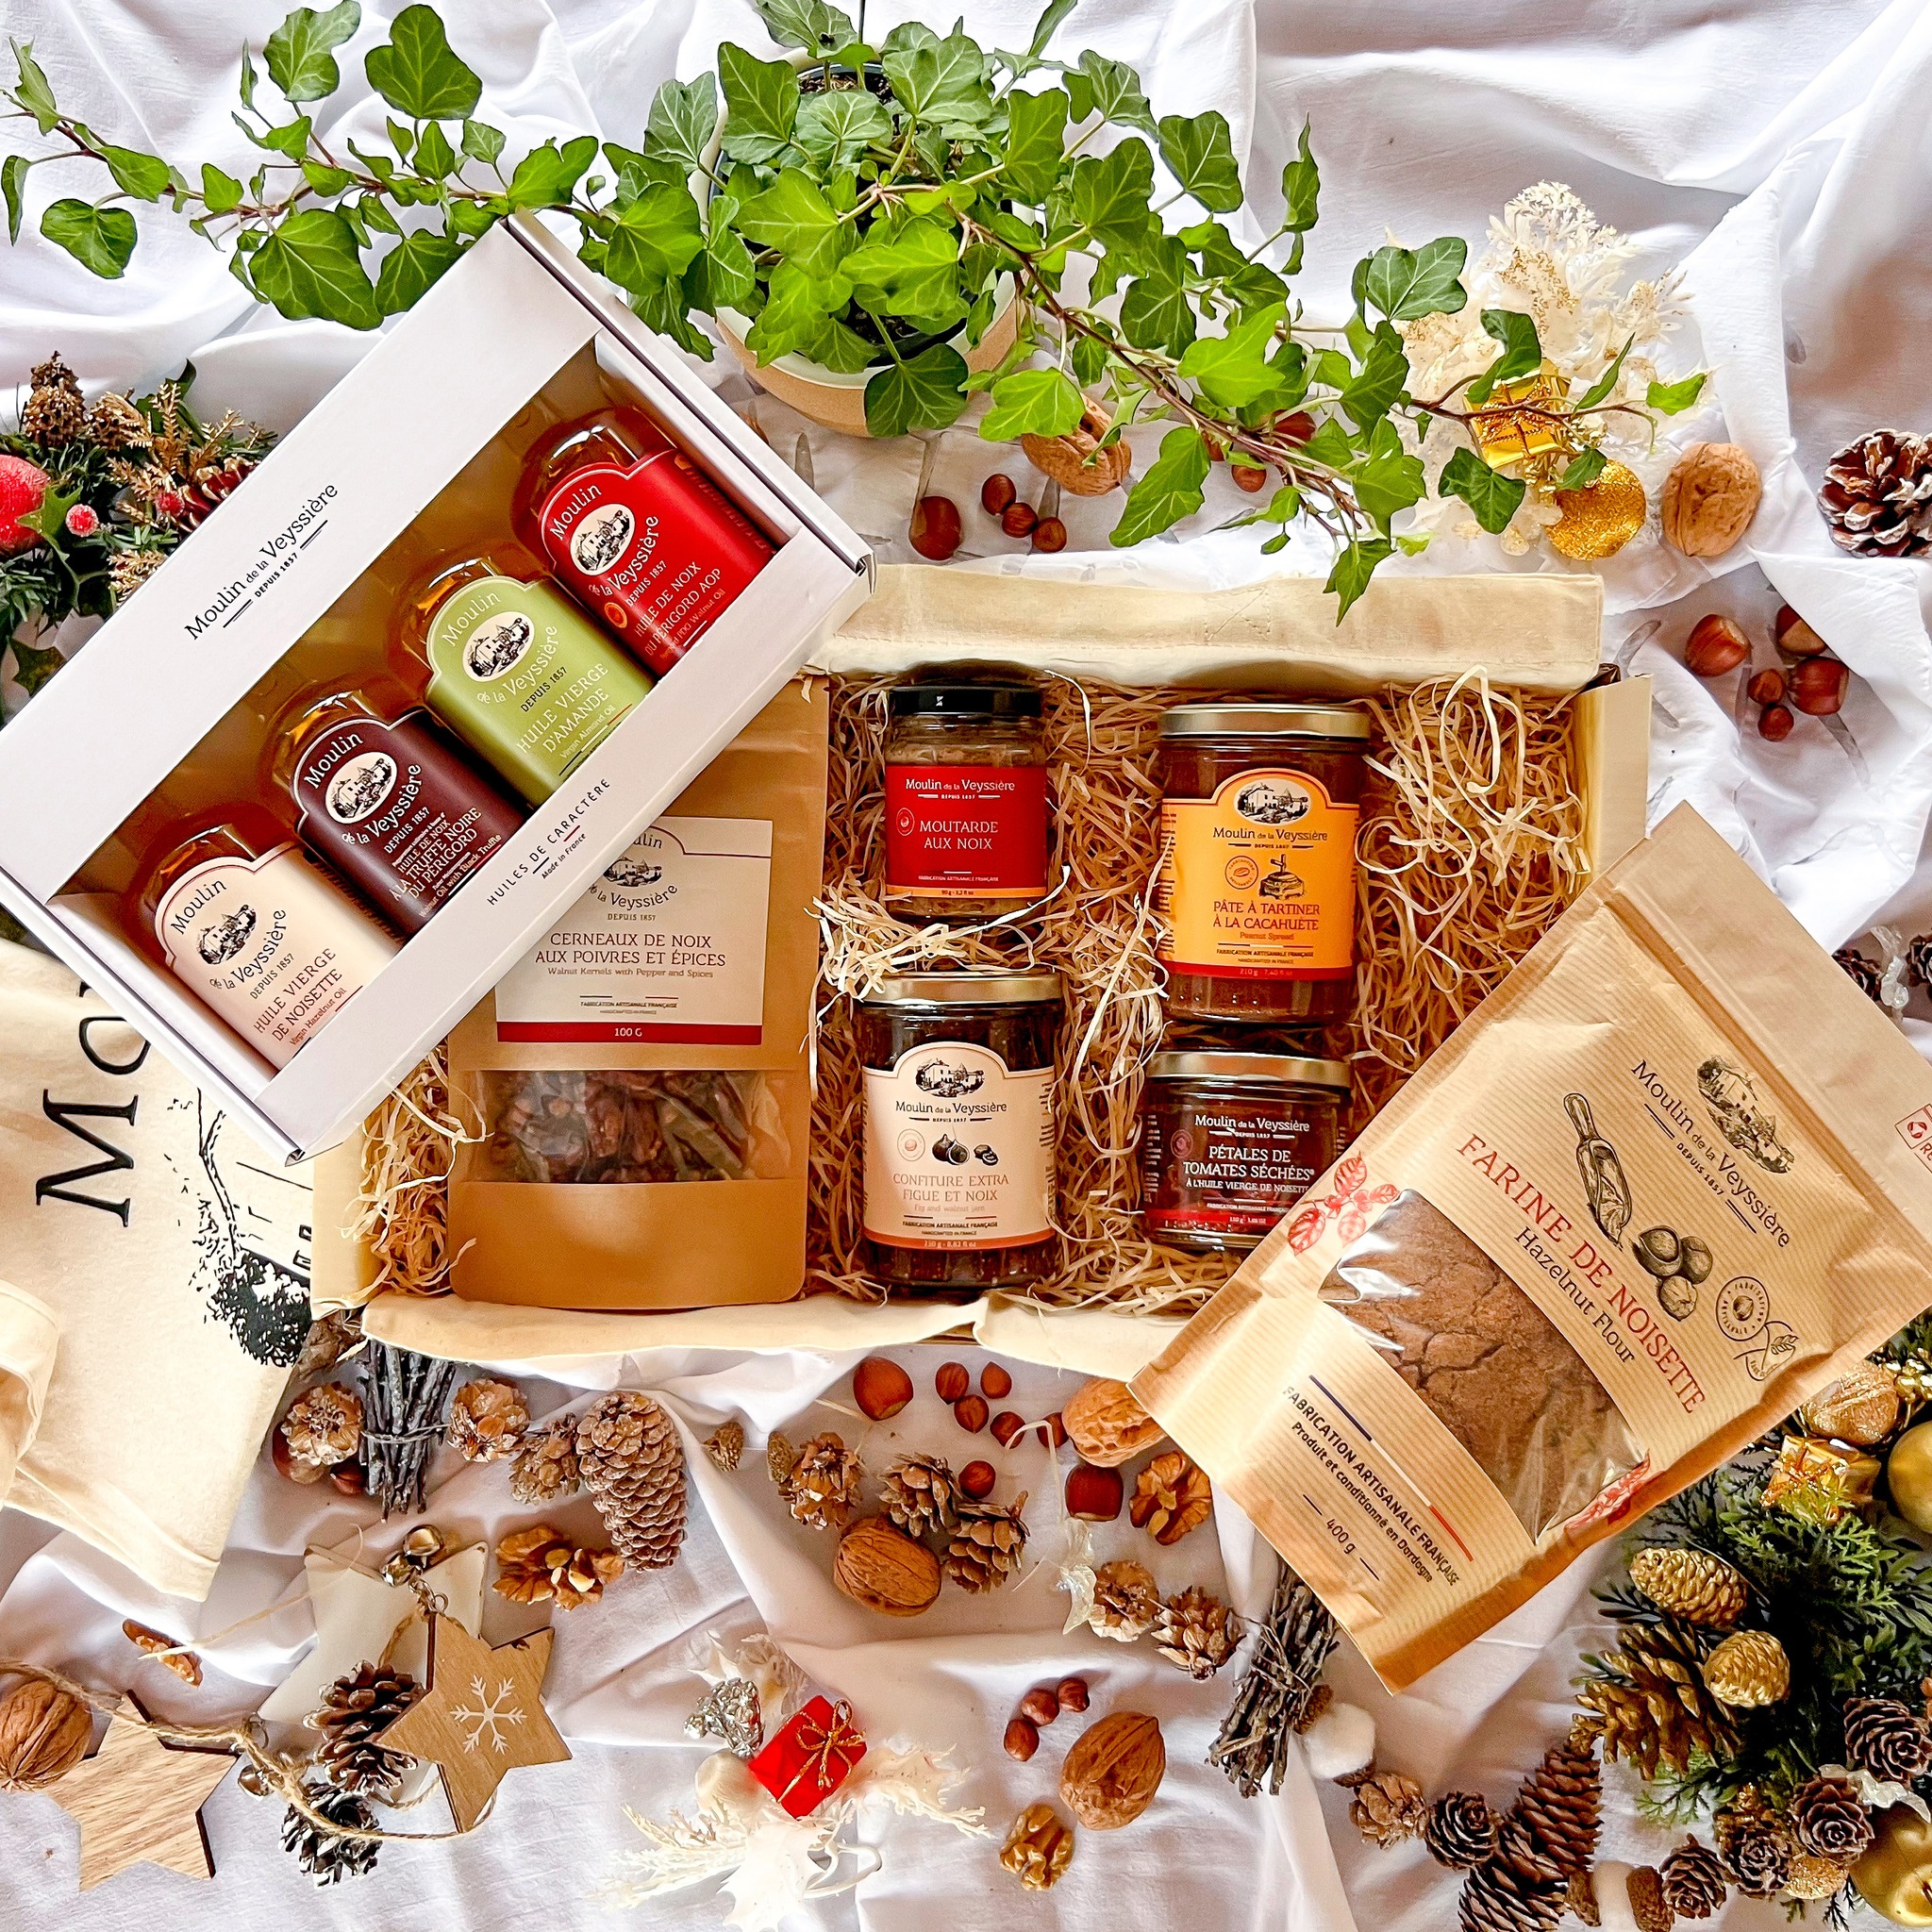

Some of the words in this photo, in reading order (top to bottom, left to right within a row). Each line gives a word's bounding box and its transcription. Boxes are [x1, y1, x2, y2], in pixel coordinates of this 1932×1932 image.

[258, 484, 339, 558] Veyssière
[549, 483, 602, 541] Moulin
[600, 583, 613, 596] la
[607, 515, 659, 591] Veyssière
[245, 570, 259, 584] de
[254, 571, 281, 598] DEPUIS
[280, 552, 298, 572] 1857
[256, 559, 270, 572] la
[625, 577, 652, 608] DEPUIS
[649, 559, 667, 579] 1857
[184, 580, 247, 641] Moulin
[634, 606, 659, 638] HUILE
[655, 589, 674, 608] DE
[670, 561, 702, 593] NOIX
[644, 640, 658, 657] DU
[698, 568, 722, 594] AOP
[713, 588, 726, 601] Oil
[441, 591, 501, 647] Moulin
[493, 691, 506, 704] la
[502, 625, 558, 696] Veyssière
[516, 709, 558, 755] HUILE
[555, 663, 608, 709] VIERGE
[520, 682, 551, 712] DEPUIS
[550, 667, 568, 685] 1857
[541, 688, 610, 754] D'AMANDE
[559, 738, 581, 760] Virgin
[578, 714, 606, 741] Almond
[603, 705, 617, 718] Oil
[304, 732, 364, 790] Moulin
[364, 764, 422, 838] Veyssière
[905, 778, 942, 791] Moulin
[960, 778, 1015, 793] Veyssière
[358, 833, 371, 844] la
[383, 824, 414, 854] DEPUIS
[411, 807, 430, 825] 1857
[397, 848, 421, 874] HUILE
[419, 837, 432, 850] DE
[429, 820, 451, 840] NOIX
[487, 863, 529, 906] HUILES
[528, 845, 547, 862] DE
[547, 778, 610, 844] CARACTÈRE
[633, 833, 662, 849] ulin
[919, 820, 999, 833] MOUTARDE
[924, 837, 952, 849] AUX
[957, 837, 993, 850] NOIX
[1212, 827, 1256, 840] Moulin
[1275, 828, 1328, 842] Veyssière
[395, 878, 412, 894] LA
[406, 839, 447, 880] TRUFFE
[443, 807, 482, 841] NOIRE
[408, 879, 426, 899] DU
[422, 828, 477, 884] PÉRIGORD
[446, 872, 463, 888] with
[477, 834, 502, 855] Truffle
[541, 861, 559, 879] Made
[558, 853, 566, 862] in
[564, 833, 587, 856] France
[597, 890, 608, 903] la
[610, 884, 678, 911] Veyssière
[1213, 898, 1244, 913] PÂTE
[1247, 899, 1257, 914] À
[1260, 902, 1321, 916] TARTINER
[1213, 913, 1223, 928] À
[1224, 916, 1241, 929] LA
[171, 880, 227, 935] Moulin
[223, 977, 236, 990] la
[230, 909, 287, 984] Veyssière
[535, 950, 567, 964] AUX
[573, 950, 641, 964] POIVRES
[645, 951, 666, 965] ET
[672, 949, 726, 967] ÉPICES
[550, 932, 639, 947] CERNEAUX
[644, 934, 666, 947] DE
[672, 934, 712, 949] NOIX
[1240, 932, 1267, 941] Peanut
[1268, 932, 1294, 941] Spread
[249, 970, 278, 1000] DEPUIS
[276, 953, 295, 972] 1857
[253, 996, 286, 1034] HUILE
[283, 948, 337, 997] VIERGE
[547, 967, 578, 975] Walnut
[580, 967, 612, 976] Kernels
[636, 968, 666, 978] Pepper
[668, 969, 685, 977] and
[687, 969, 714, 979] Spices
[272, 1024, 290, 1041] DE
[291, 968, 342, 1026] NOISETTE
[290, 1027, 308, 1046] Virgin
[305, 998, 336, 1030] Hazelnut
[333, 987, 347, 1000] Oil
[614, 1027, 633, 1038] 100
[634, 1027, 642, 1038] G
[36, 980, 151, 1227] Mo
[895, 1101, 933, 1113] Moulin
[952, 1101, 1008, 1116] Veyssière
[1194, 1114, 1236, 1128] Moulin
[1248, 1121, 1256, 1129] la
[1256, 1117, 1309, 1132] Veyssière
[1183, 1161, 1247, 1178] TOMATES
[1208, 1144, 1268, 1161] PÉTALES
[1272, 1149, 1291, 1163] DE
[1631, 1059, 1694, 1134] Moulin
[1691, 1134, 1706, 1150] de
[1705, 1145, 1716, 1161] la
[1717, 1150, 1790, 1248] Veyssière
[1675, 1142, 1705, 1174] DEPUIS
[1703, 1173, 1724, 1196] 1857
[892, 1173, 963, 1187] CONFITURE
[969, 1174, 1009, 1187] EXTRA
[903, 1190, 940, 1202] FIGUE
[944, 1191, 960, 1202] ET
[965, 1190, 998, 1202] NOIX
[1186, 1177, 1192, 1188] À
[1192, 1178, 1224, 1189] L'HUILE
[1224, 1181, 1257, 1191] VIERGE
[1259, 1183, 1273, 1191] DE
[1274, 1184, 1309, 1193] NOISETT
[914, 1204, 925, 1212] Fig
[926, 1204, 941, 1212] and
[943, 1204, 970, 1212] walnut
[1456, 1133, 1573, 1243] FARINE
[1568, 1239, 1613, 1289] DE
[1607, 1283, 1706, 1414] NOISETTE
[1513, 1224, 1595, 1317] Hazelnut
[1591, 1310, 1636, 1364] Flour
[1282, 1386, 1357, 1464] FABRICATION
[1353, 1461, 1421, 1537] ARTISANALE
[1417, 1532, 1460, 1587] FRANÇAISE
[1291, 1421, 1328, 1462] Produit
[1325, 1458, 1339, 1474] et
[1336, 1470, 1389, 1529] conditionné
[1386, 1525, 1399, 1541] en
[1397, 1538, 1433, 1583] Dordogne
[1325, 1518, 1351, 1543] 400
[1343, 1541, 1357, 1555] g
